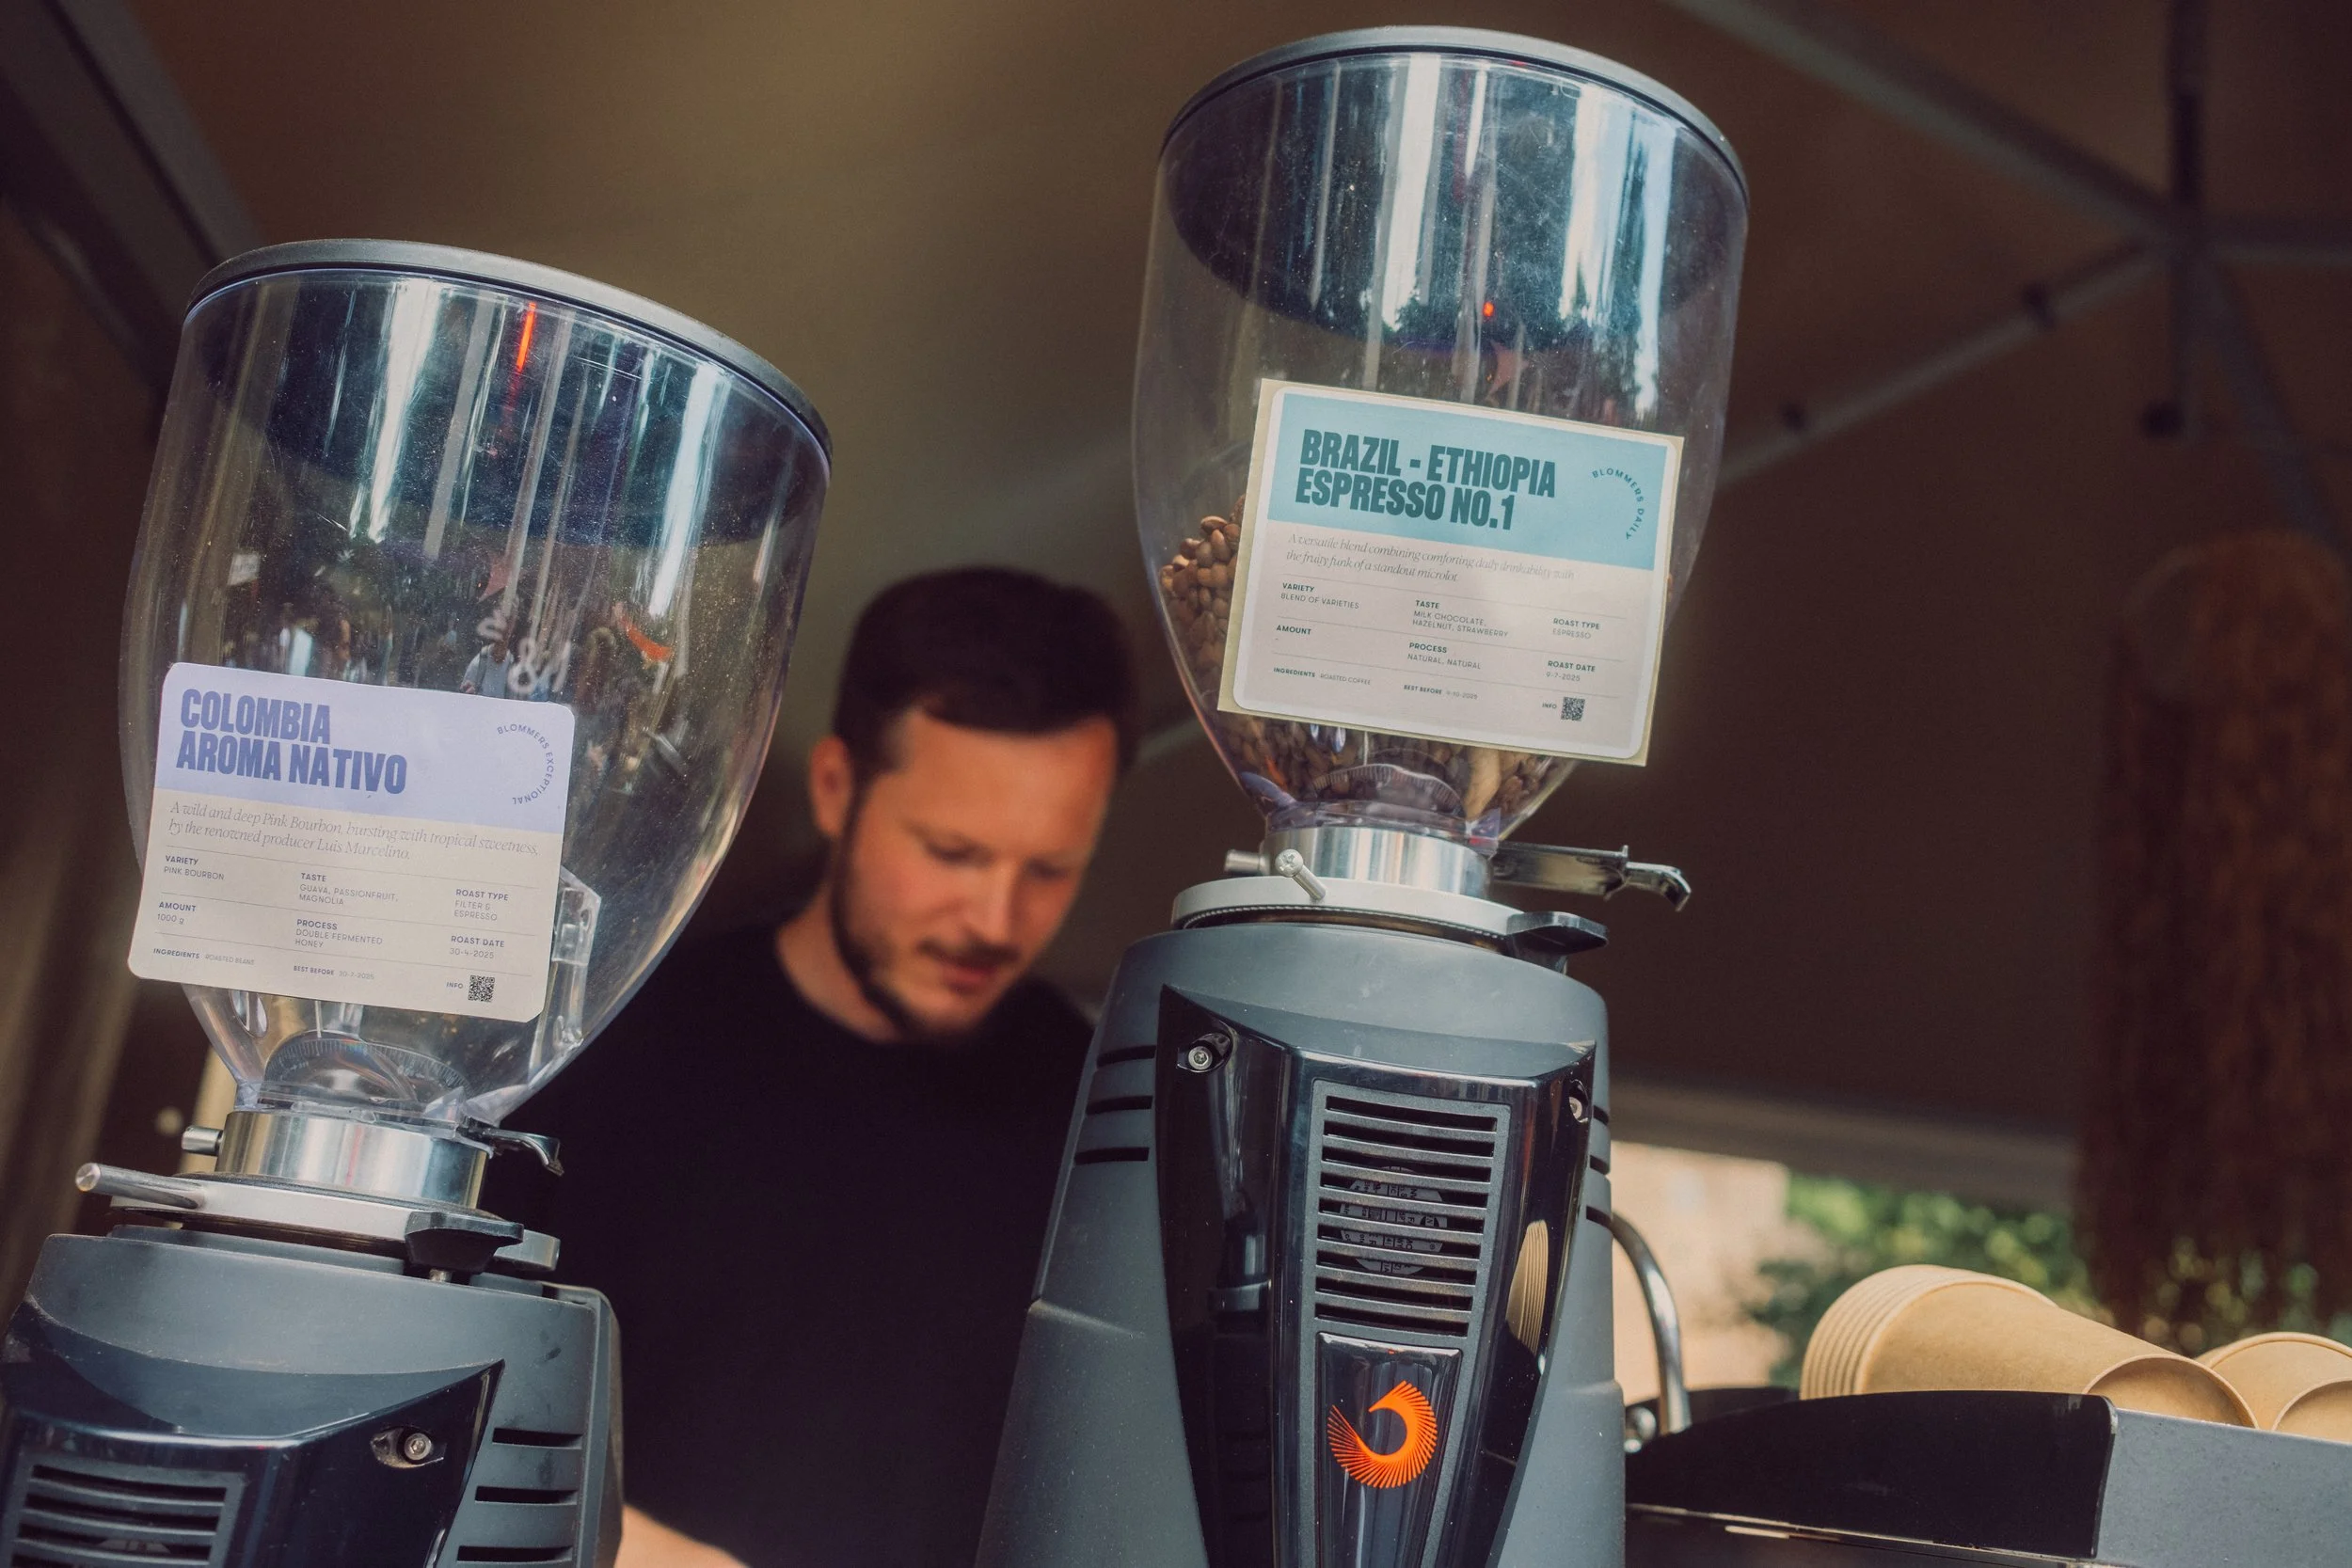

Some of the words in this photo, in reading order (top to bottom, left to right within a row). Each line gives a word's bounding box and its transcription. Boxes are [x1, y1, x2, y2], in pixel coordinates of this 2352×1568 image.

[1300, 429, 1402, 477] BRAZIL
[1410, 459, 1421, 468] -
[1427, 445, 1555, 499] ETHIOPIA
[1295, 467, 1446, 521] ESPRESSO
[1451, 488, 1516, 531] NO.1
[1592, 468, 1644, 502] BLOMMERS
[1627, 508, 1645, 540] DAILY
[1287, 550, 1300, 561] the
[1302, 550, 1328, 565] fruity
[1328, 556, 1353, 568] funk
[1354, 559, 1365, 571] of
[1374, 562, 1416, 576] standout
[1288, 534, 1296, 544] A
[1298, 535, 1339, 548] versatile
[1340, 539, 1368, 553] blend
[1369, 546, 1422, 562] combining
[1422, 551, 1475, 569] comforting
[1476, 558, 1500, 571] daily
[1500, 561, 1552, 580] drinkability
[1553, 570, 1575, 579] with
[1282, 582, 1314, 593] VARIETY
[1280, 594, 1306, 602] BLEND
[1322, 598, 1359, 610] VARIETIES
[1416, 600, 1439, 609] TASTE
[1414, 610, 1432, 619] MILK
[1435, 613, 1486, 626] CHOCOLATE,
[1553, 618, 1580, 627] ROAST
[1581, 622, 1599, 630] TYPE
[1277, 625, 1311, 635] AMOUNT
[1413, 620, 1454, 631] HAZELNUT,
[1457, 626, 1508, 637] STRAWBERRY
[1553, 628, 1591, 640] ESPRESSO
[1409, 642, 1447, 653] PROCESS
[1407, 654, 1444, 664] NATURAL,
[1447, 658, 1481, 670] NATURAL
[1548, 660, 1573, 669] ROAST
[1576, 664, 1596, 673] DATE
[1274, 668, 1315, 677] INGREDIENTS
[1321, 673, 1346, 682] ROASTED
[1348, 676, 1371, 685] COFFEE
[1420, 687, 1442, 695] BEFORE
[181, 689, 330, 744] COLOMBIA
[497, 724, 549, 749] BLOMMERS
[176, 730, 281, 781] AROMA
[289, 744, 407, 795] NATIVO
[513, 752, 554, 804] EXCEPTIONAL
[170, 801, 180, 814] A
[183, 803, 207, 817] wild
[209, 807, 231, 821] and
[234, 809, 262, 827] deep
[262, 813, 288, 827] Pink
[290, 816, 342, 835] Bourbon,
[347, 822, 397, 842] bursting
[400, 829, 427, 843] with
[430, 832, 478, 848] tropical
[168, 819, 183, 835] by
[185, 821, 202, 835] the
[204, 827, 261, 843] renowned
[262, 833, 318, 849] producer
[317, 839, 342, 853] Luis
[345, 842, 410, 860] Marcelino.
[166, 855, 199, 865] VARIETY
[164, 866, 183, 875] PINK
[185, 869, 224, 880] BOURBON
[301, 873, 327, 882] TASTE
[300, 884, 330, 895] GUAVA,
[334, 888, 398, 902] PASSIONFRUIT,
[456, 889, 485, 898] ROAST
[488, 893, 509, 901] TYPE
[159, 902, 196, 911] AMOUNT
[299, 895, 343, 905] MAGNOLIA
[455, 900, 483, 910] FILTER
[157, 914, 176, 923] 1000
[454, 911, 498, 922] ESPRESSO
[297, 919, 338, 930] PROCESS
[296, 928, 329, 939] DOUBLE
[332, 933, 383, 945] FERMENTED
[452, 936, 480, 944] ROAST
[294, 939, 324, 948] HONEY
[153, 948, 199, 959] INGREDIENTS
[205, 954, 233, 963] ROASTED
[450, 948, 495, 959] 30-4-2025
